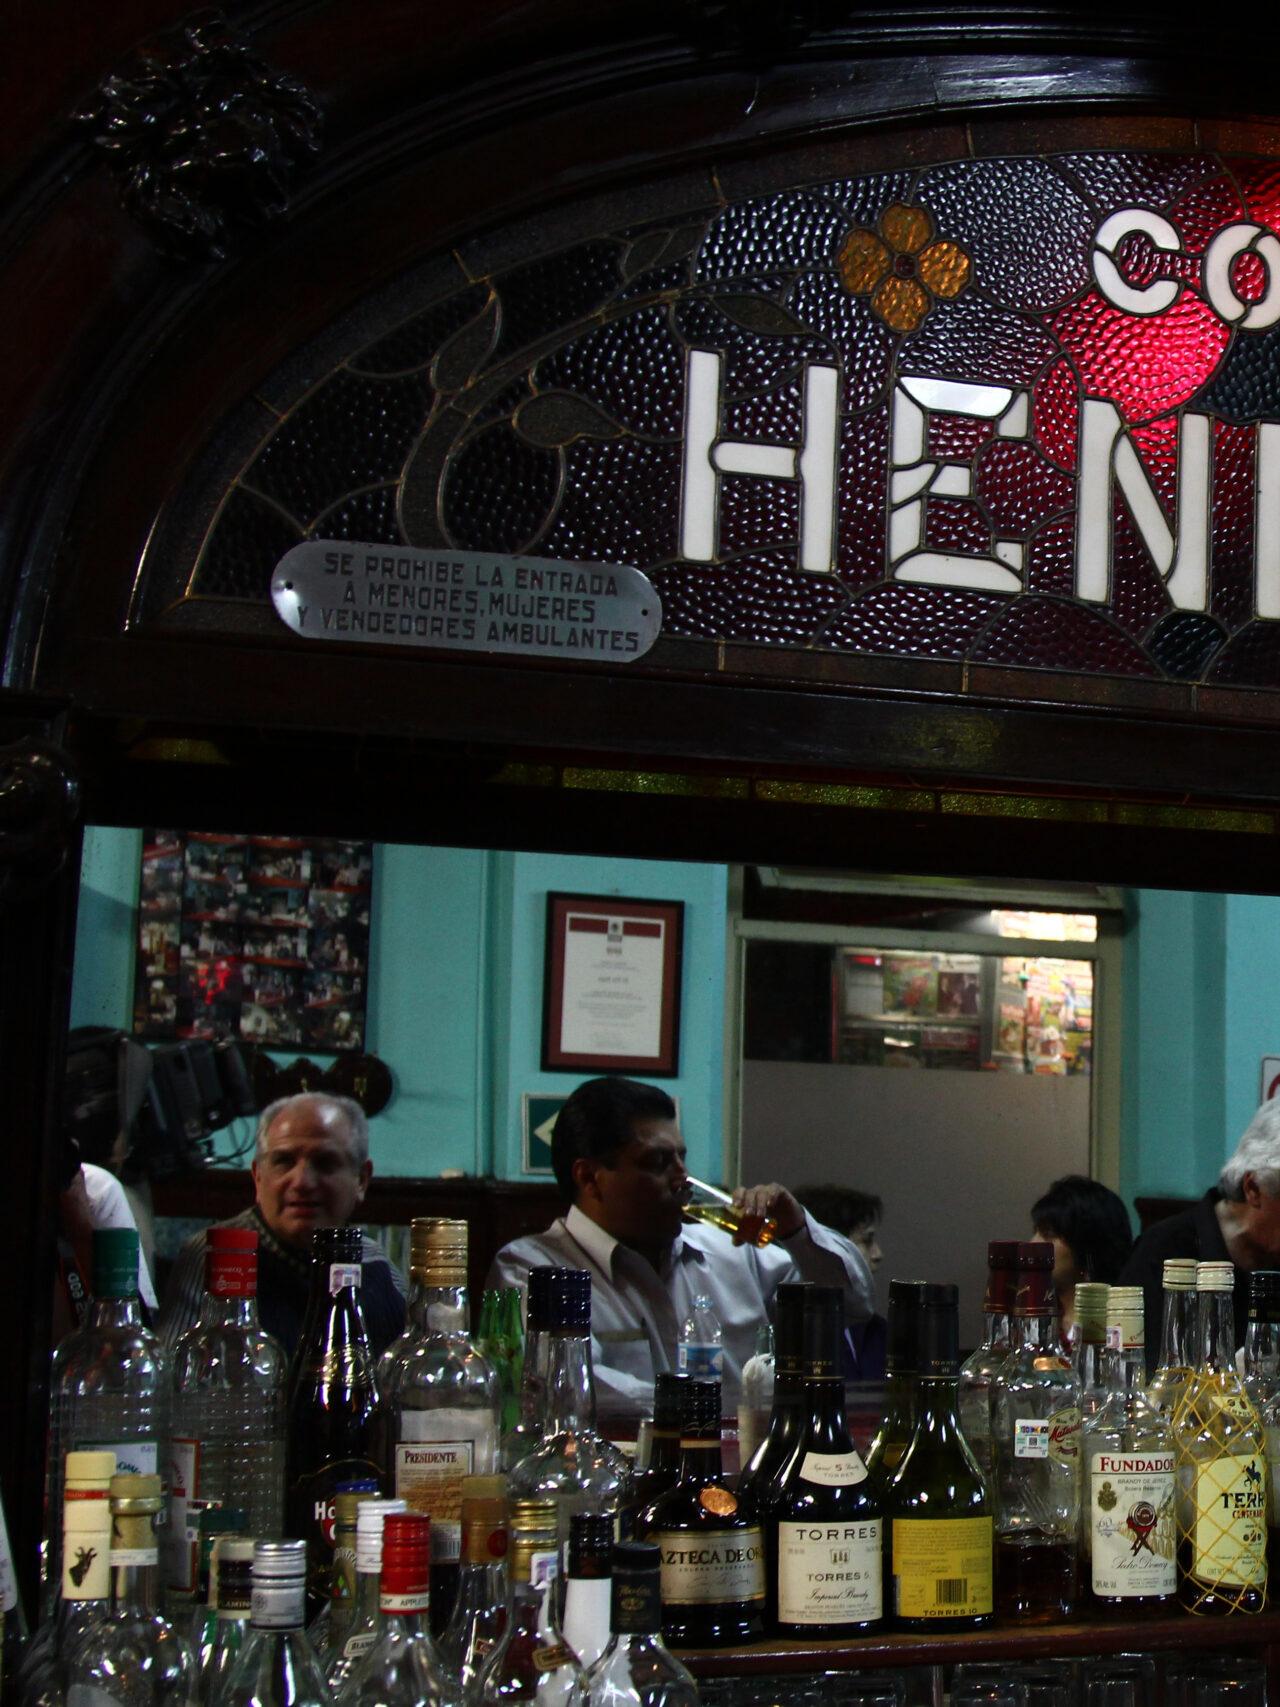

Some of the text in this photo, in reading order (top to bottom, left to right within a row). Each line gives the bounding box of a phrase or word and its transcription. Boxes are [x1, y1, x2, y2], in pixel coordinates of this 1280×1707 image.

[324, 551, 619, 598] SE PROHIBE LA ENTRADA
[298, 606, 639, 653] Y VENDEDORES AMBULANTES
[404, 1450, 458, 1465] PRESIDENTE
[1100, 1457, 1174, 1472] FUNDADOR
[1221, 1491, 1265, 1509] TERR
[796, 1526, 877, 1541] TORRES
[658, 1549, 721, 1565] AZTECA
[725, 1548, 746, 1564] DE
[808, 1571, 861, 1581] TORRES
[923, 1607, 978, 1617] TORRES 10
